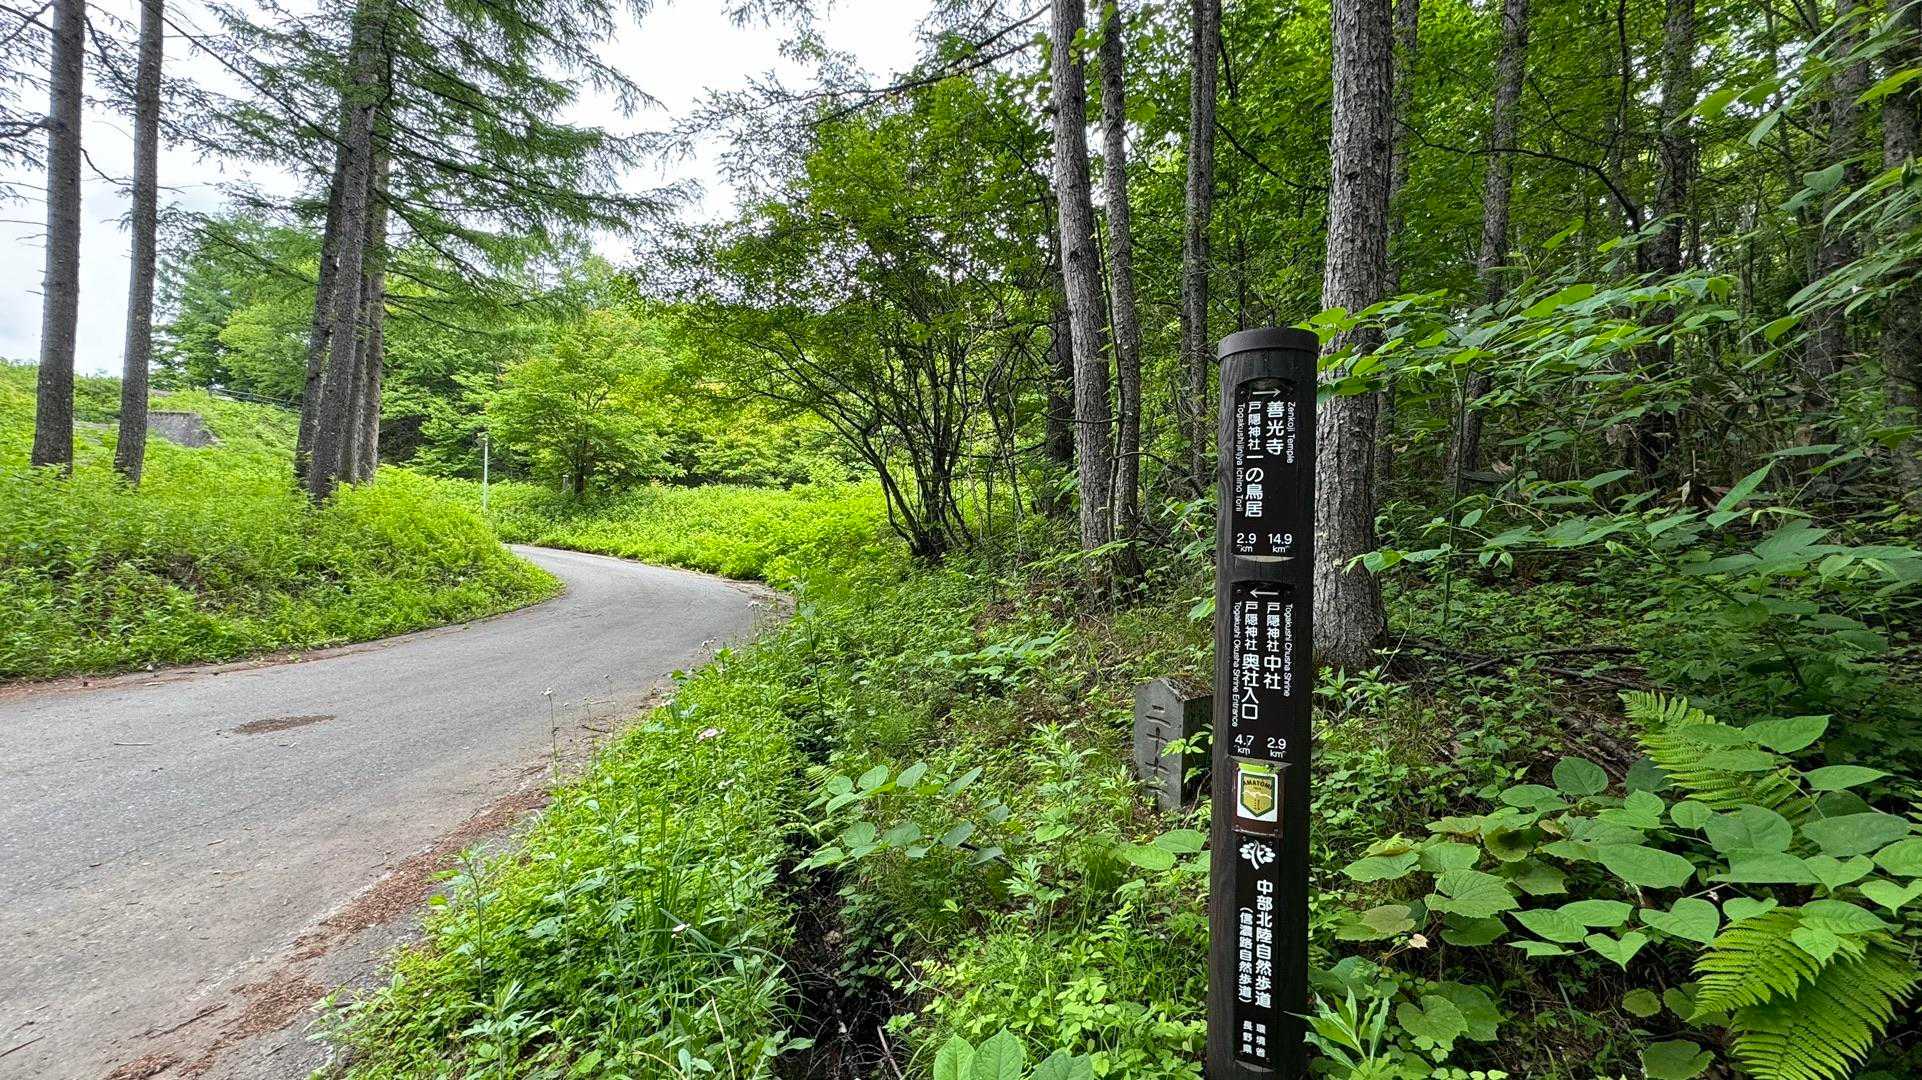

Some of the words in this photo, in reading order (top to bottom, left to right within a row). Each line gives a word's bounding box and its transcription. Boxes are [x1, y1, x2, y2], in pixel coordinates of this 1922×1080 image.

[1265, 400, 1285, 456] 善光寺
[1286, 401, 1296, 432] Zenkoji
[1246, 401, 1264, 518] 戸隠神社一の鳥居
[1286, 433, 1296, 464] Temple
[1235, 467, 1244, 493] Ichino
[1234, 494, 1244, 512] Torii
[1236, 532, 1257, 545] 2.9
[1240, 545, 1253, 553] km
[1267, 533, 1293, 545] 14.9
[1272, 545, 1286, 553] km
[1232, 601, 1242, 639] Togakushi
[1283, 603, 1294, 641] Togakushi
[1232, 639, 1241, 668] Okusha
[1263, 602, 1282, 690] 戸隠神社中社
[1283, 642, 1293, 671] Chusha
[1241, 601, 1260, 720] 戸隠神社奥社入口
[1232, 668, 1241, 693] Shrine
[1283, 672, 1292, 697] Shrine
[1231, 694, 1240, 728] Entrance
[1234, 734, 1255, 746] 4.7
[1237, 746, 1251, 755] km
[1266, 737, 1287, 750] 2.9
[1269, 750, 1284, 759] km
[1255, 879, 1273, 1009] 中部北陸自然歩道
